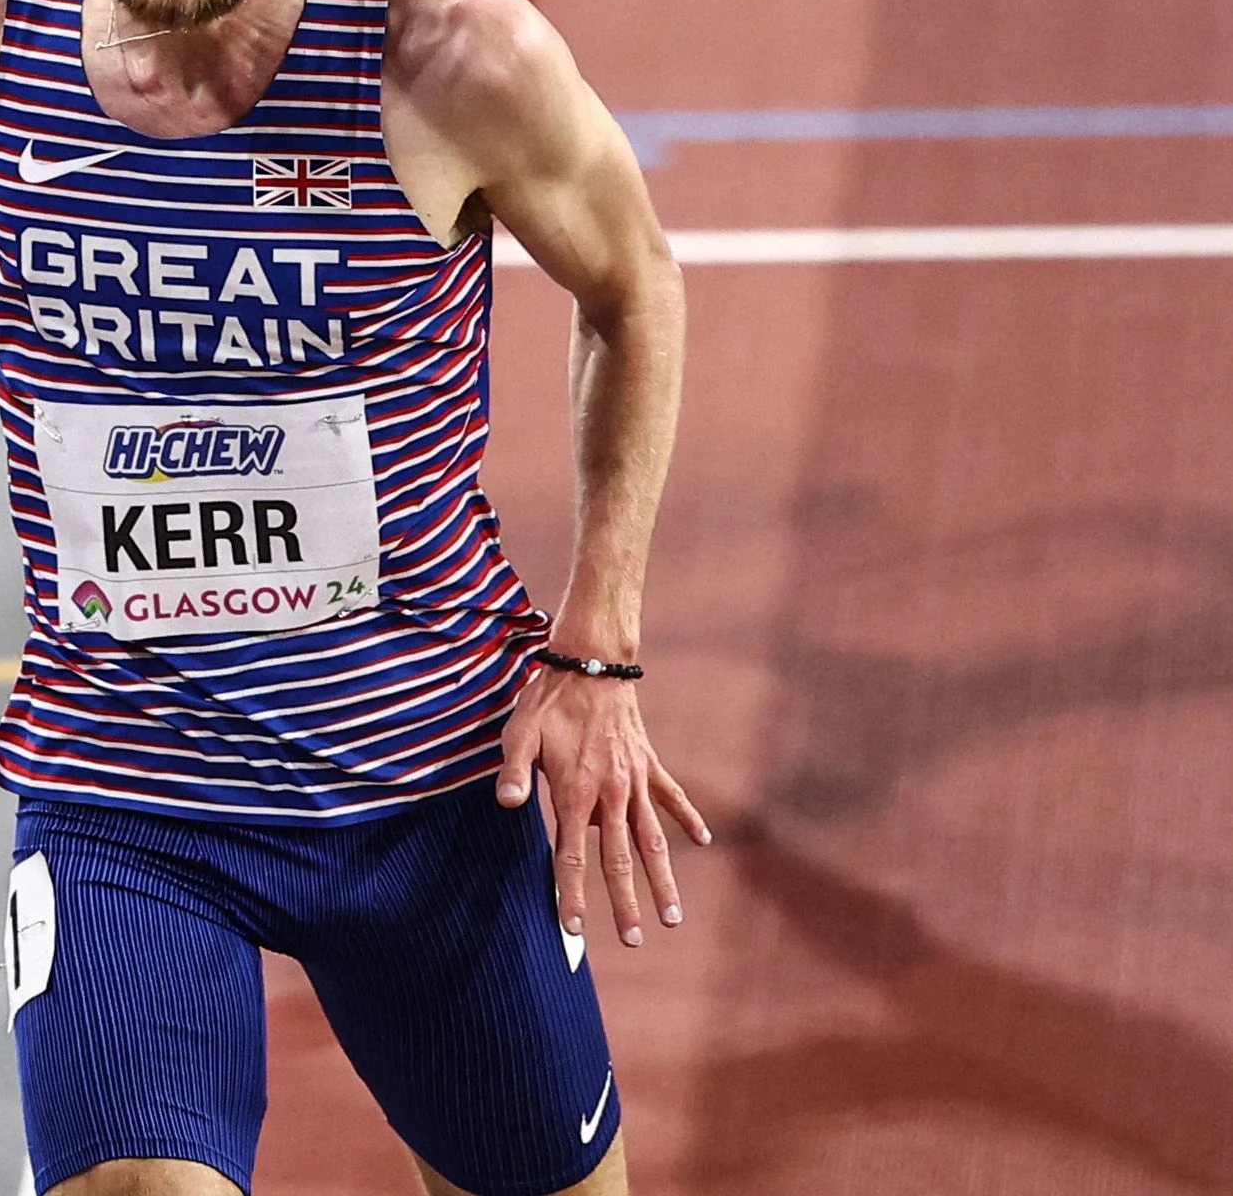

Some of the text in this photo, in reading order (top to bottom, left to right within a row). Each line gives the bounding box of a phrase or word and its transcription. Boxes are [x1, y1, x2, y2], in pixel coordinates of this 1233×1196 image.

[20, 227, 340, 306] GREAT
[27, 293, 345, 367] BRITAIN
[104, 425, 285, 479] HI-CHEW
[101, 499, 304, 572] KERR
[124, 575, 366, 622] GLASGOW 24
